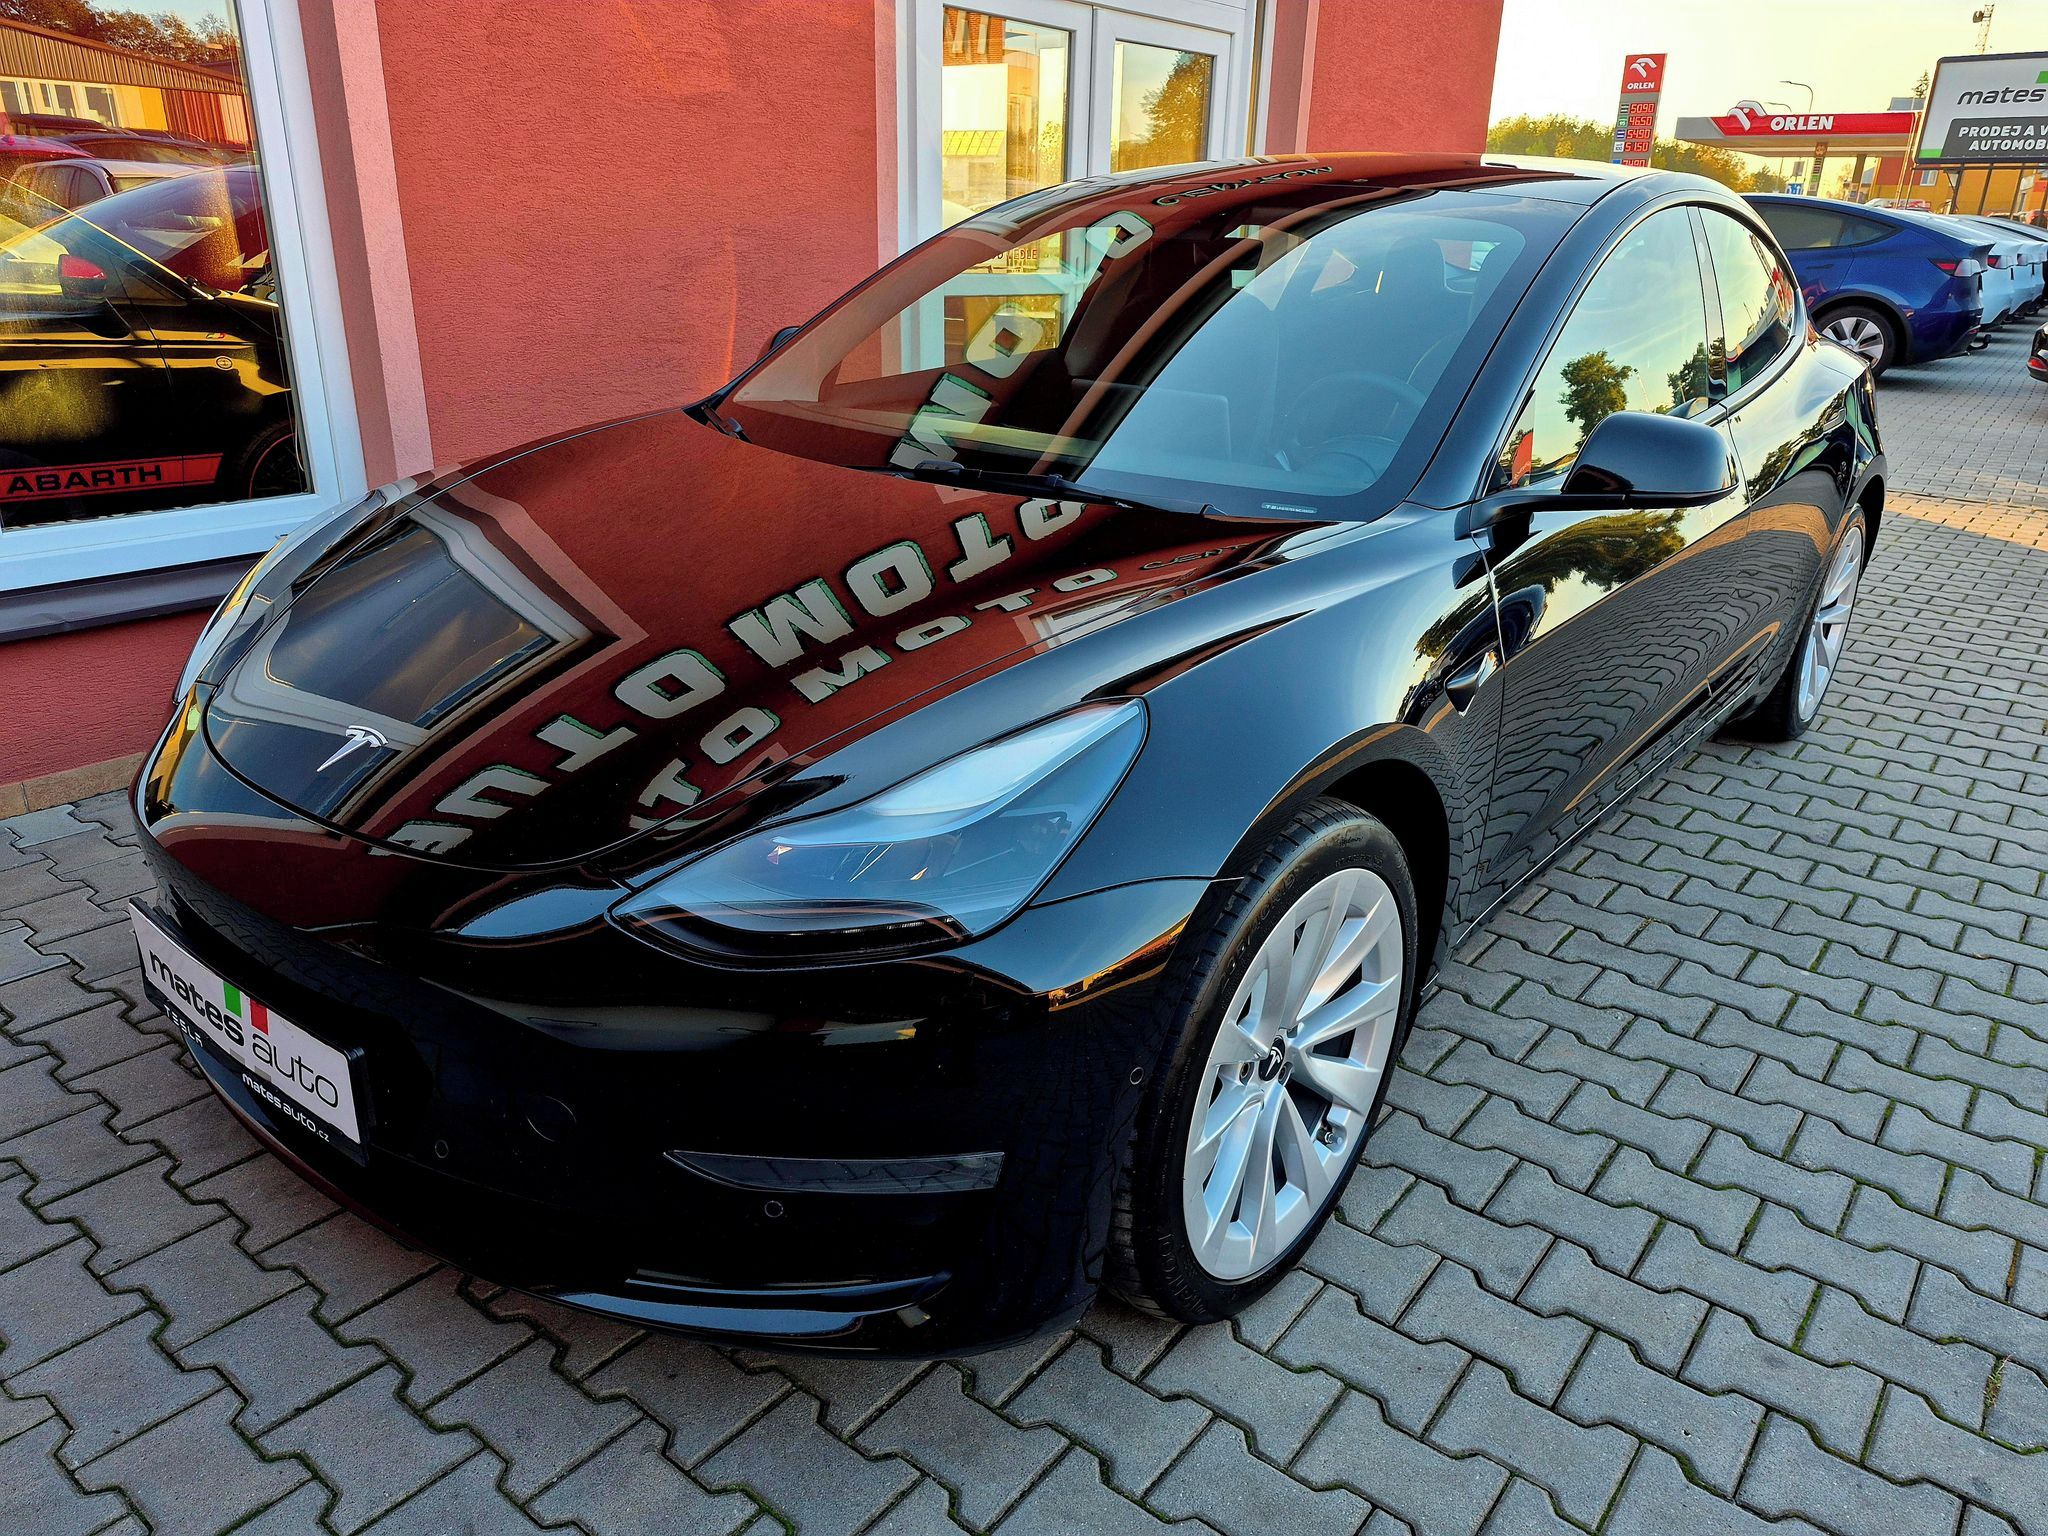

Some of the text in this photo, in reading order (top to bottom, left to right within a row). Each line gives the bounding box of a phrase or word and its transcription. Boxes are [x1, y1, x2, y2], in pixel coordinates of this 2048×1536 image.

[1626, 81, 1655, 90] ORLEN
[1957, 86, 2047, 105] mates
[1630, 103, 1655, 114] 5090
[1629, 116, 1653, 126] 4650
[1770, 115, 1834, 132] ORLEN
[1626, 129, 1651, 139] 5490
[1958, 125, 2022, 137] PRODEJ
[2023, 125, 2035, 136] A
[1624, 142, 1649, 152] 5150
[1968, 139, 2048, 151] AUTOMOB
[7, 465, 162, 494] ABARTH
[149, 949, 339, 1108] mates auto
